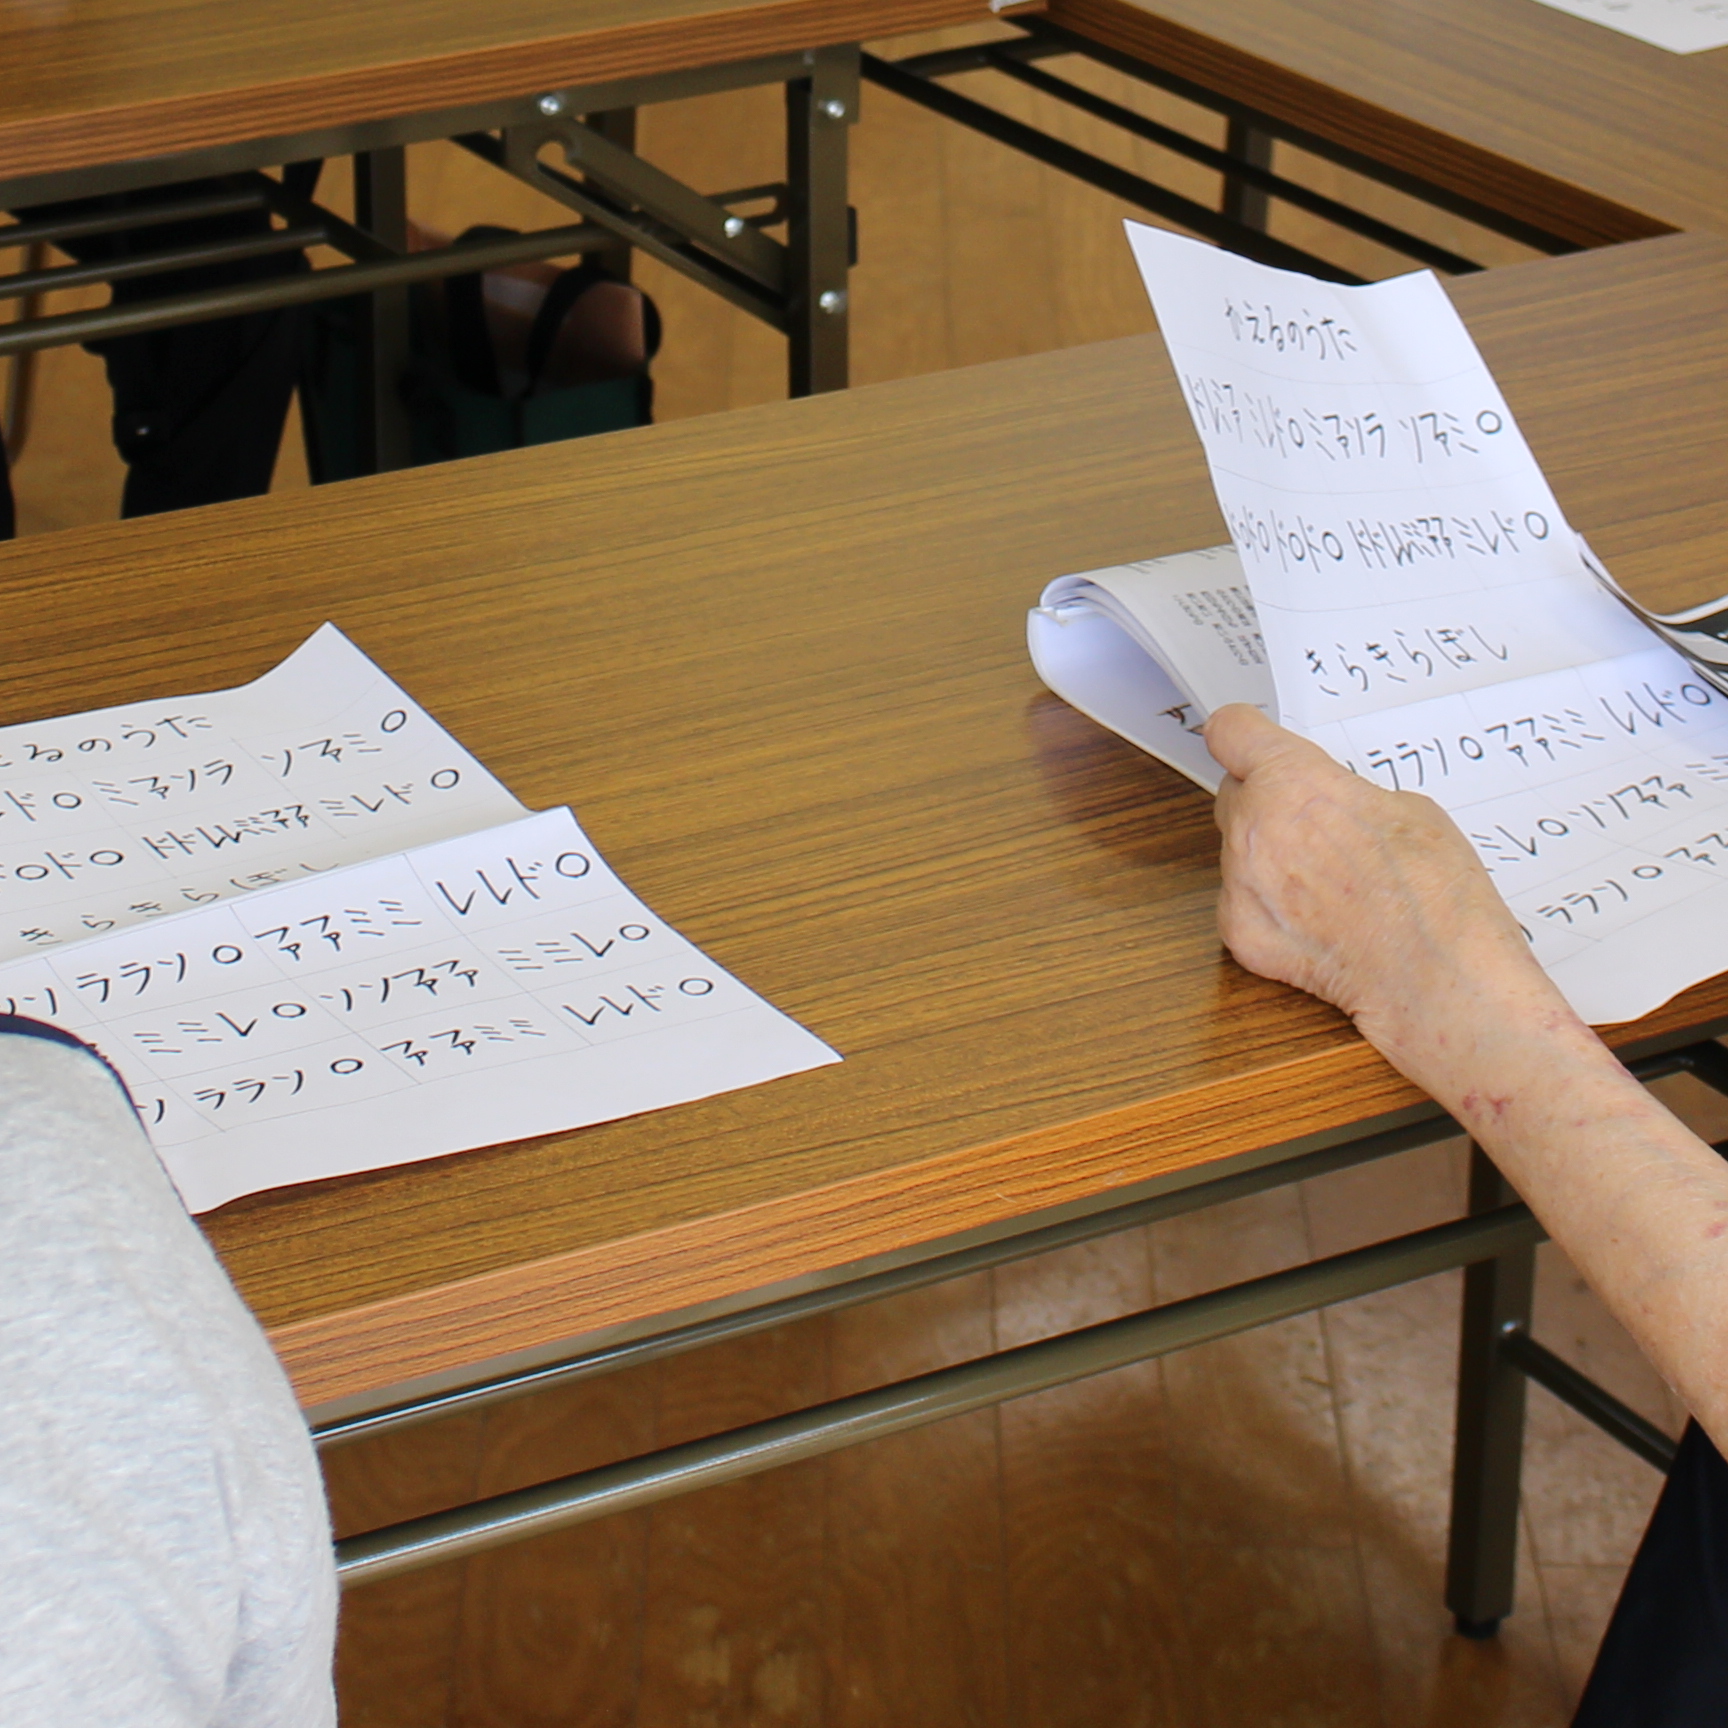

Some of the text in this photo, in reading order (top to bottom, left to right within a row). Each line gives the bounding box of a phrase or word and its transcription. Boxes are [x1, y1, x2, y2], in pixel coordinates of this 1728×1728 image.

[1225, 298, 1357, 360] かえるのうた
[1305, 624, 1508, 696] きらきらぼし
[20, 862, 340, 946] きらきらぼし
